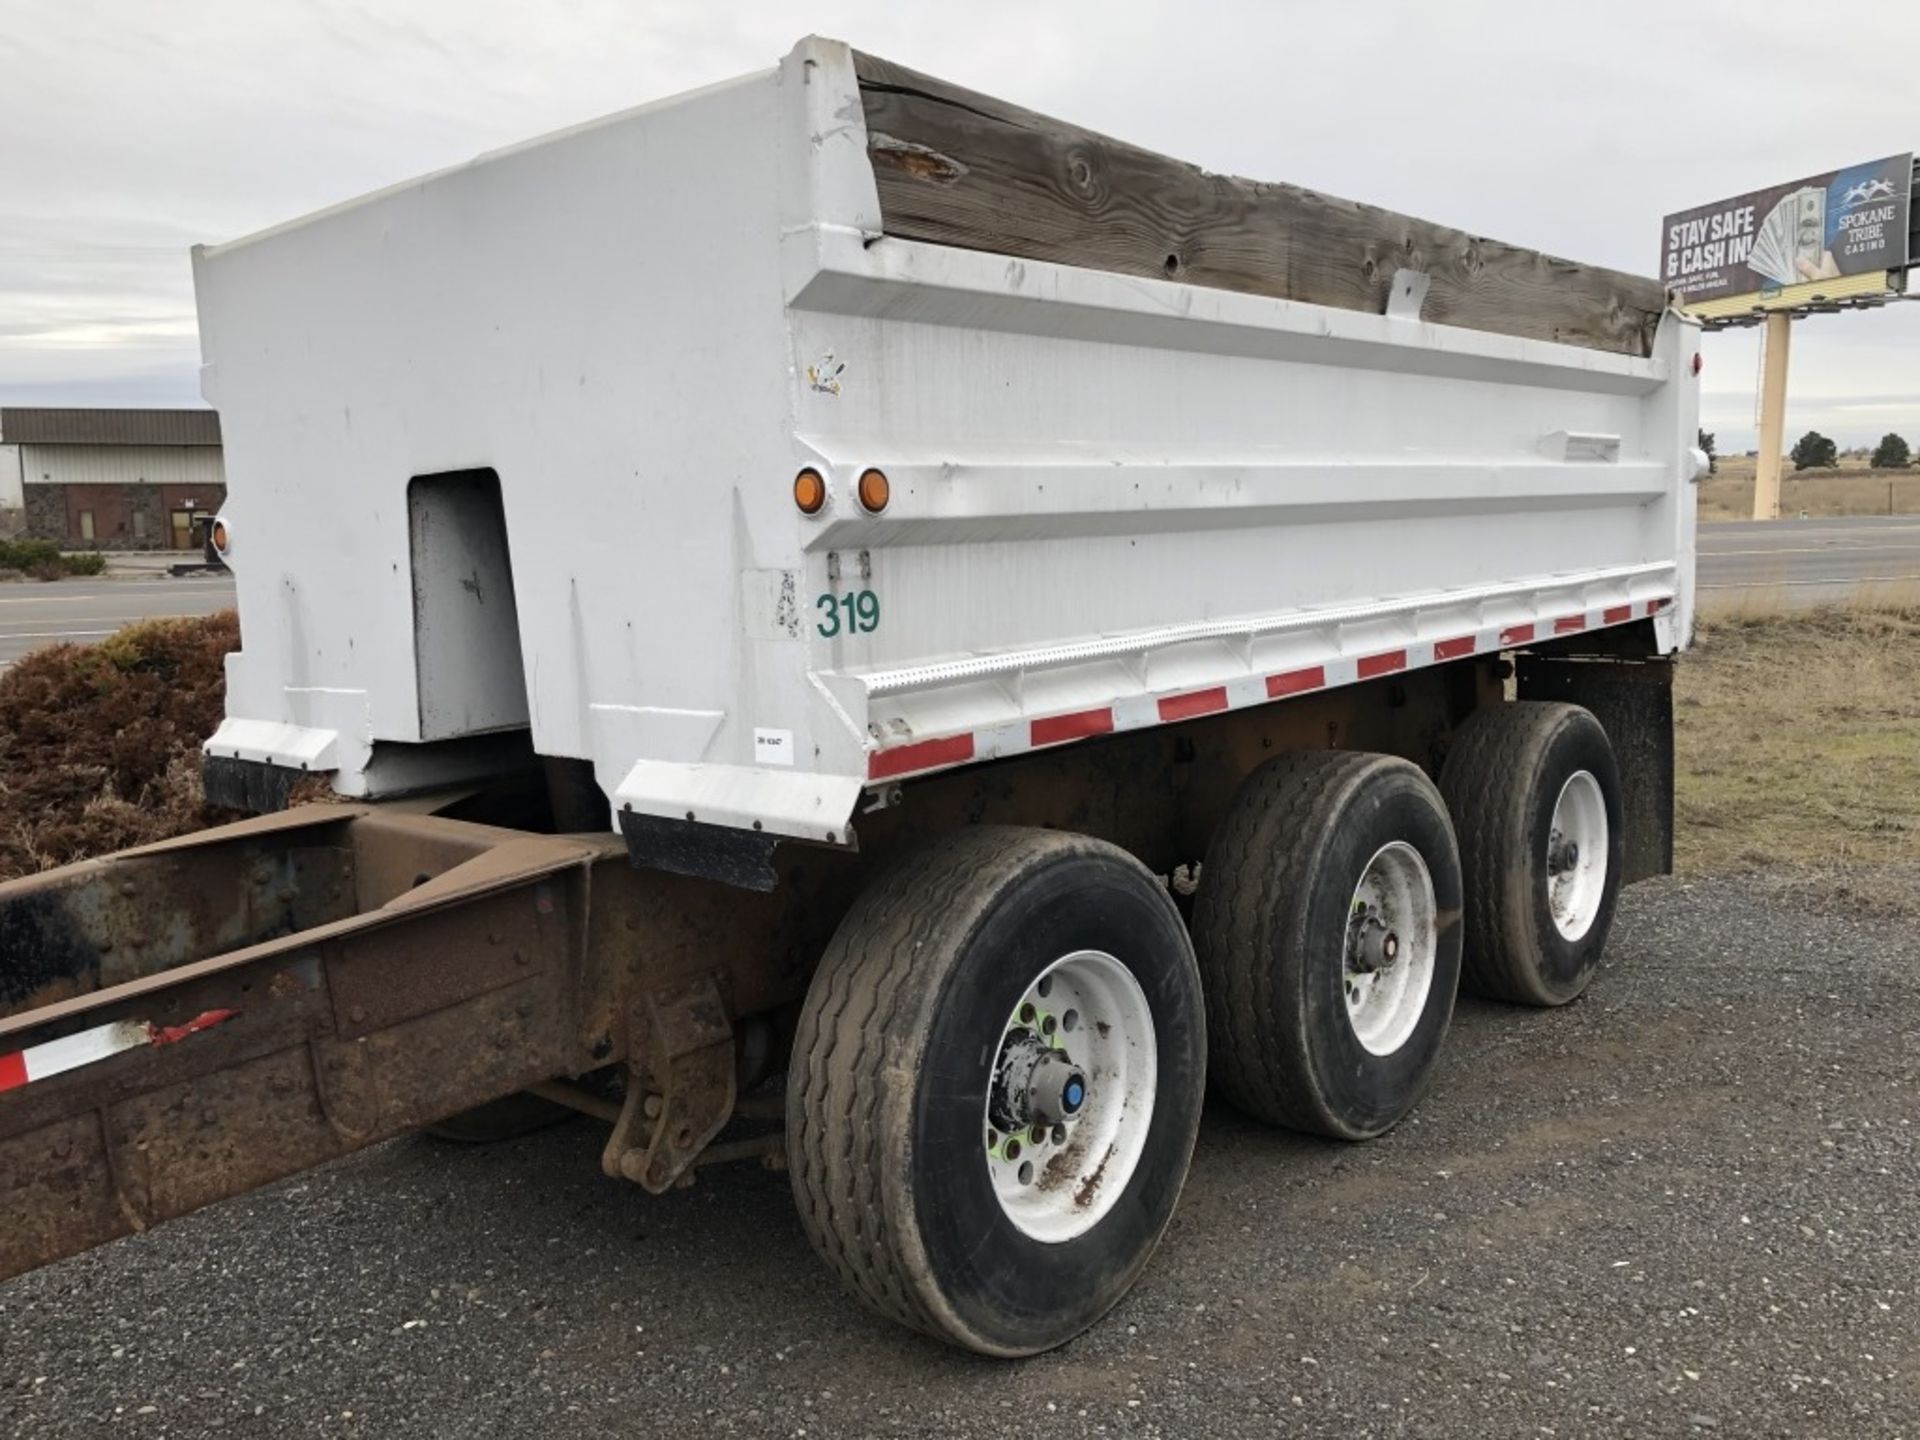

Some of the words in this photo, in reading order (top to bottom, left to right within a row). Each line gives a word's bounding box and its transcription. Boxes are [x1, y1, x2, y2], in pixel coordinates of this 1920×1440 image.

[1669, 217, 1710, 250] STAY
[1711, 206, 1755, 240] SAFE
[1838, 205, 1896, 230] SPOKANE
[1848, 222, 1884, 243] TRIBE
[1667, 252, 1679, 277] &
[1681, 241, 1726, 274] CASH
[1728, 234, 1754, 265] IN!
[1844, 238, 1886, 256] CASINO
[816, 590, 880, 638] 319
